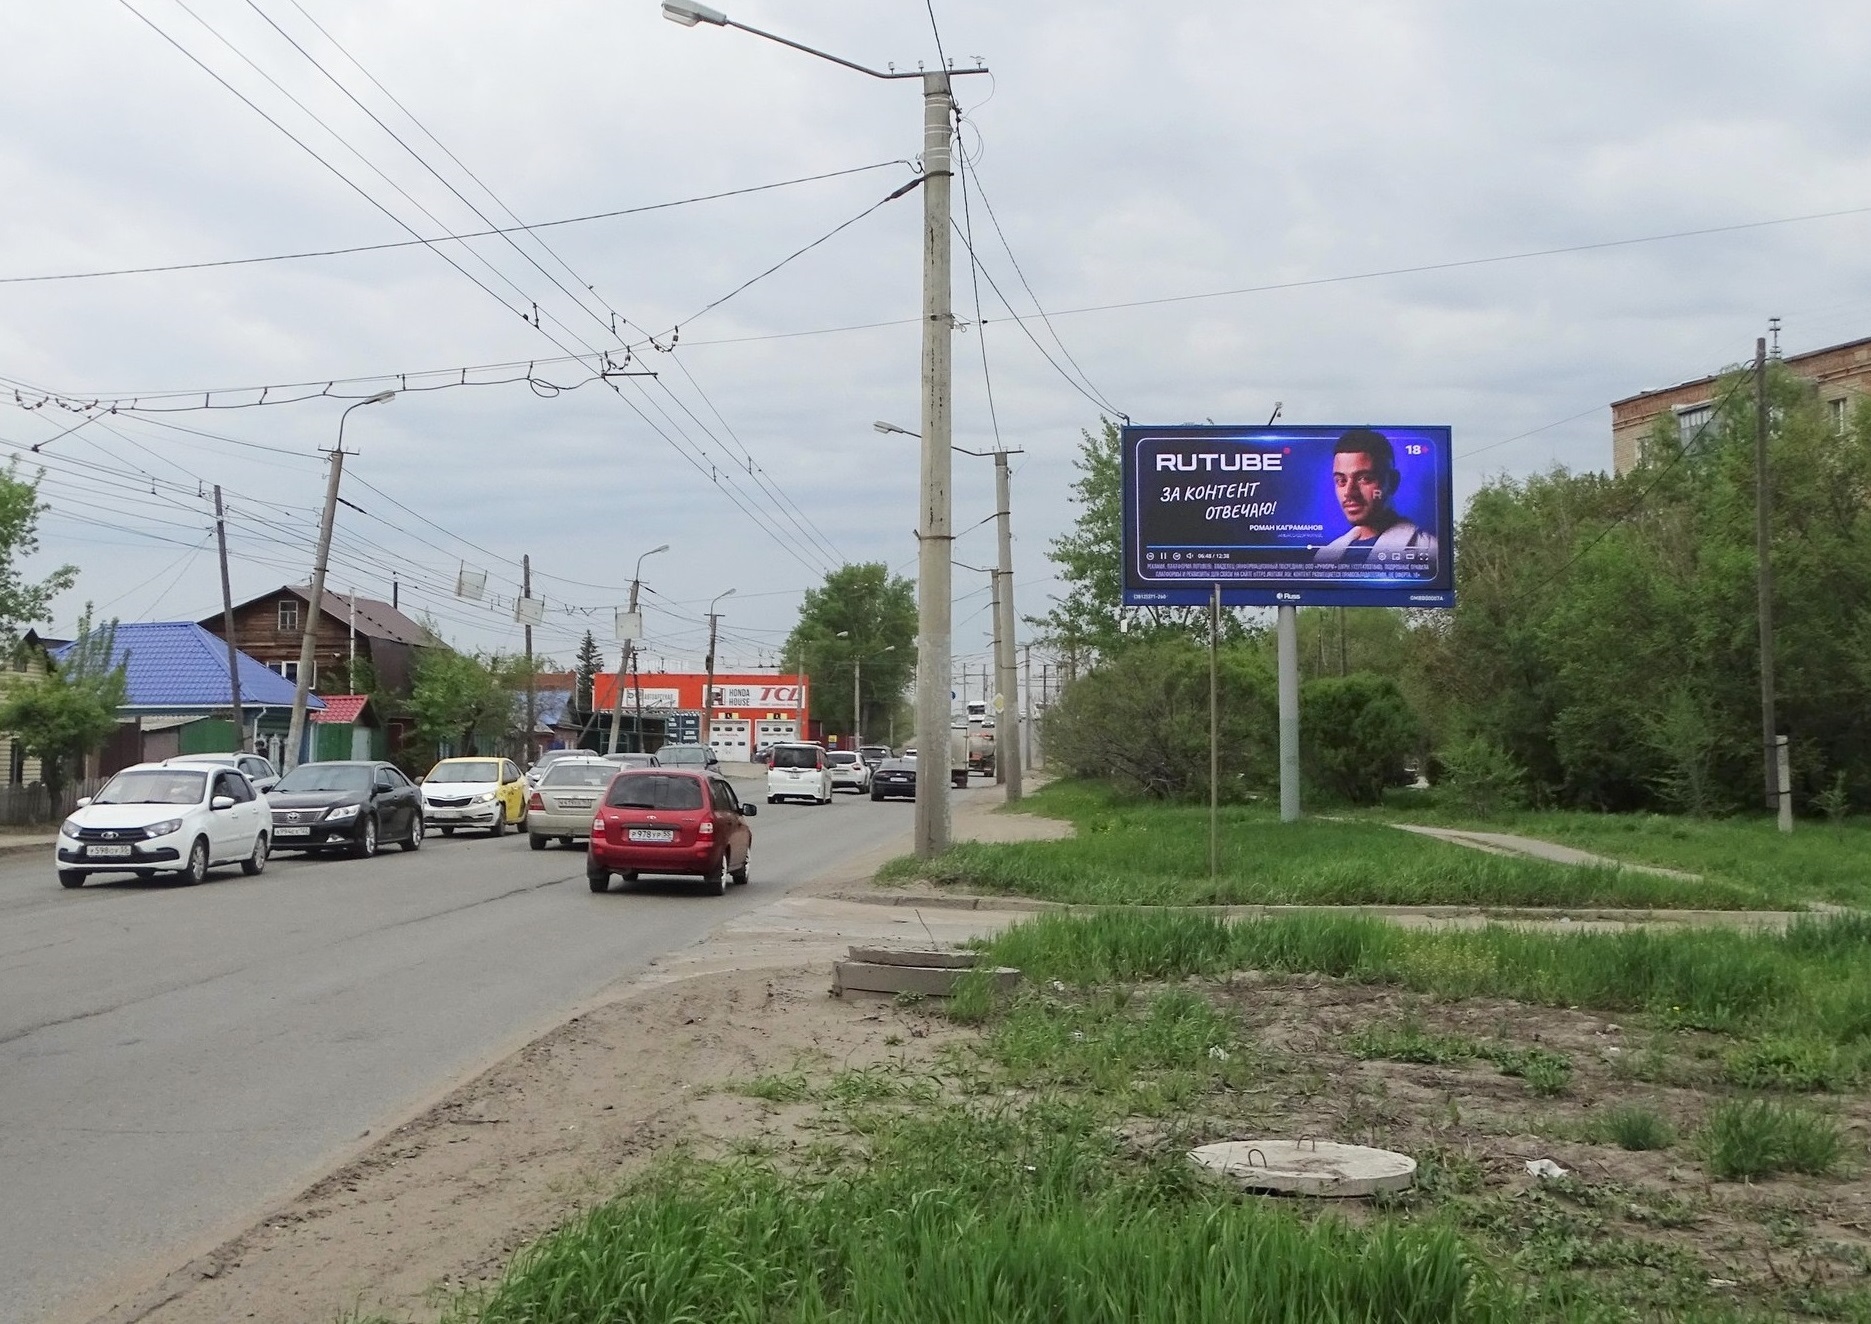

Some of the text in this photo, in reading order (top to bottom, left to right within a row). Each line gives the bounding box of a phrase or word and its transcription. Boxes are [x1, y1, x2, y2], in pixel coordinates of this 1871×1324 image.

[1156, 453, 1283, 471] RUTUBE
[1160, 482, 1261, 503] ЗА КОНТЕНТ
[1205, 500, 1278, 521] ОТВЕЧАЮ!
[1249, 524, 1324, 532] РОМАН КАГРАМАНОВ
[1283, 592, 1301, 600] Russ
[729, 688, 750, 697] HONDA
[729, 698, 750, 707] HOUSE
